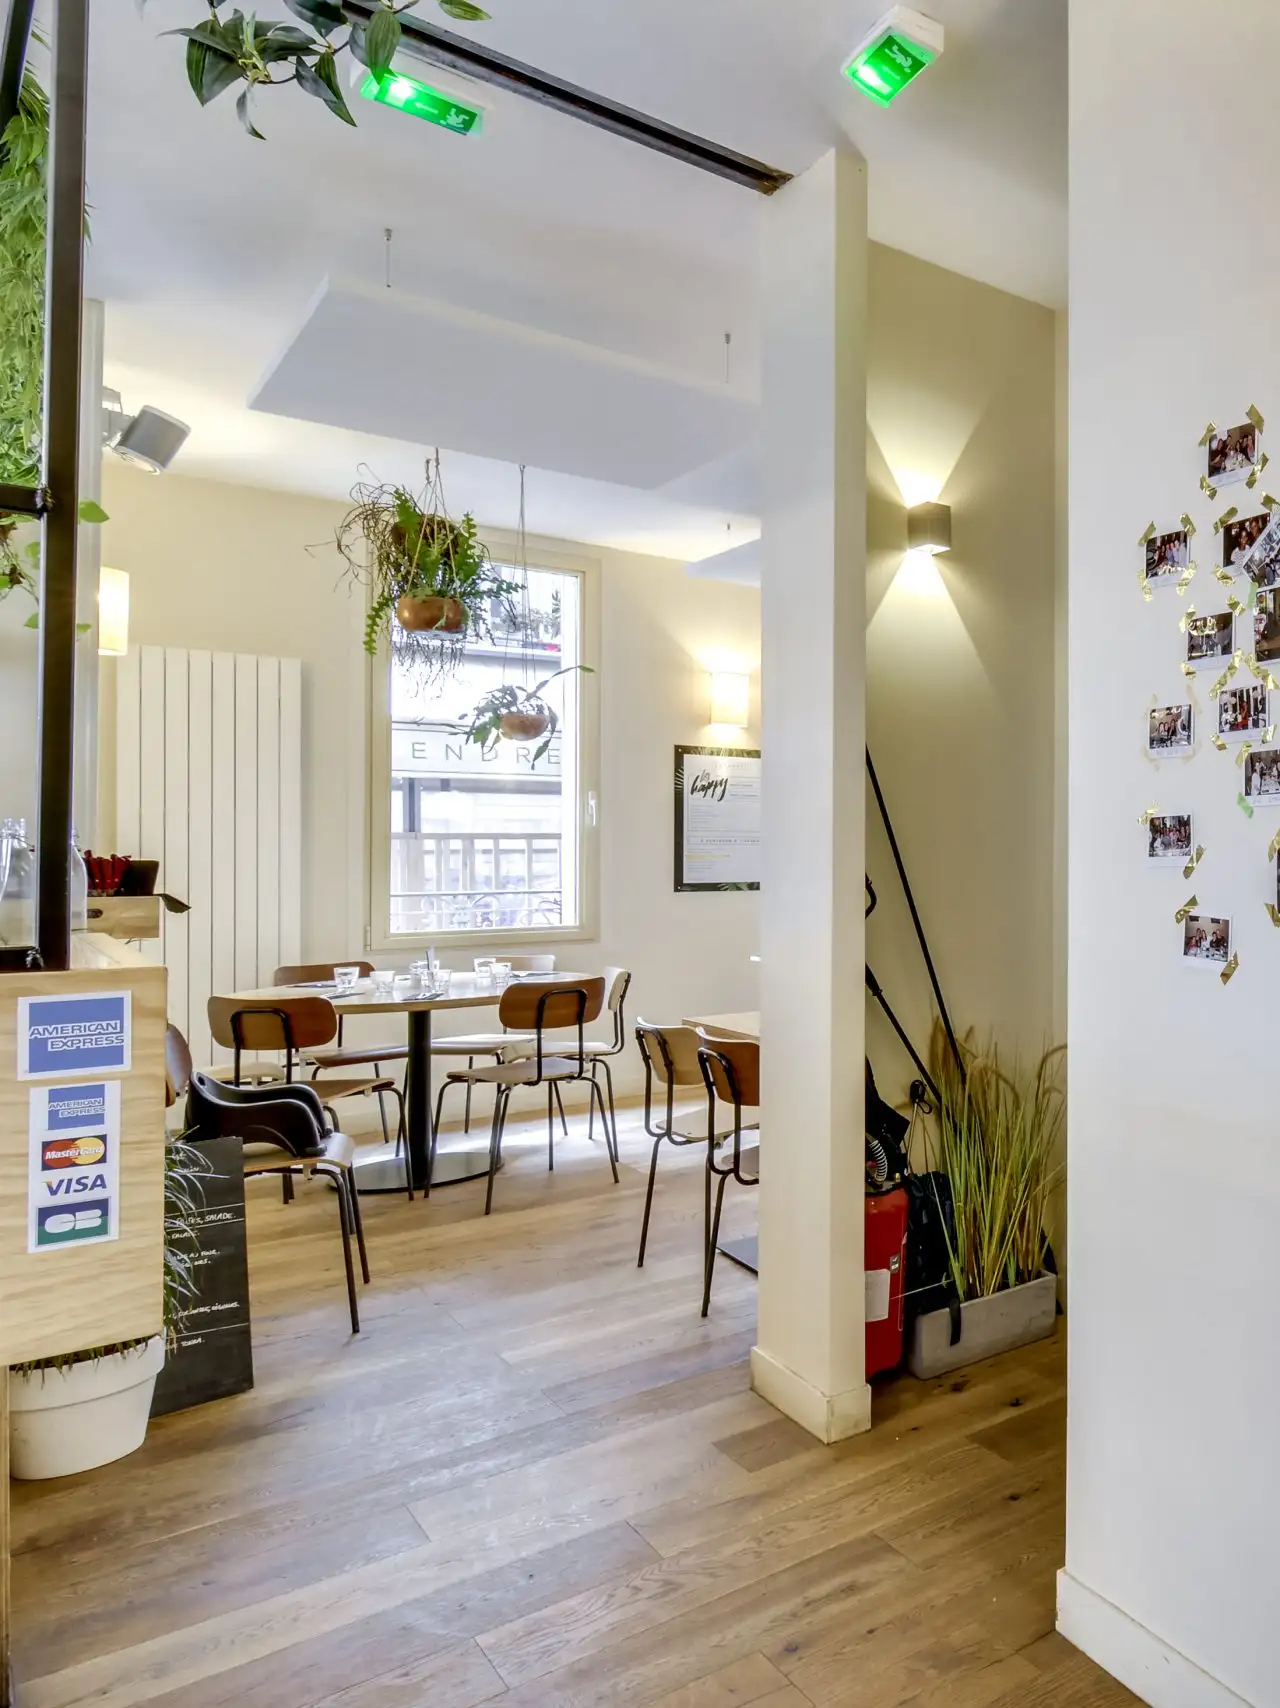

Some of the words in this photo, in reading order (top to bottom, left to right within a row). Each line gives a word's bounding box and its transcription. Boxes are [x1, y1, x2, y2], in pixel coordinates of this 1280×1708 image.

[29, 1021, 119, 1038] AMERICAN
[49, 1034, 124, 1051] EXPRESS
[48, 1098, 102, 1110] AMERICAN
[59, 1106, 105, 1118] EXPRESS
[45, 1147, 103, 1160] MasterCard
[43, 1173, 107, 1196] VISA
